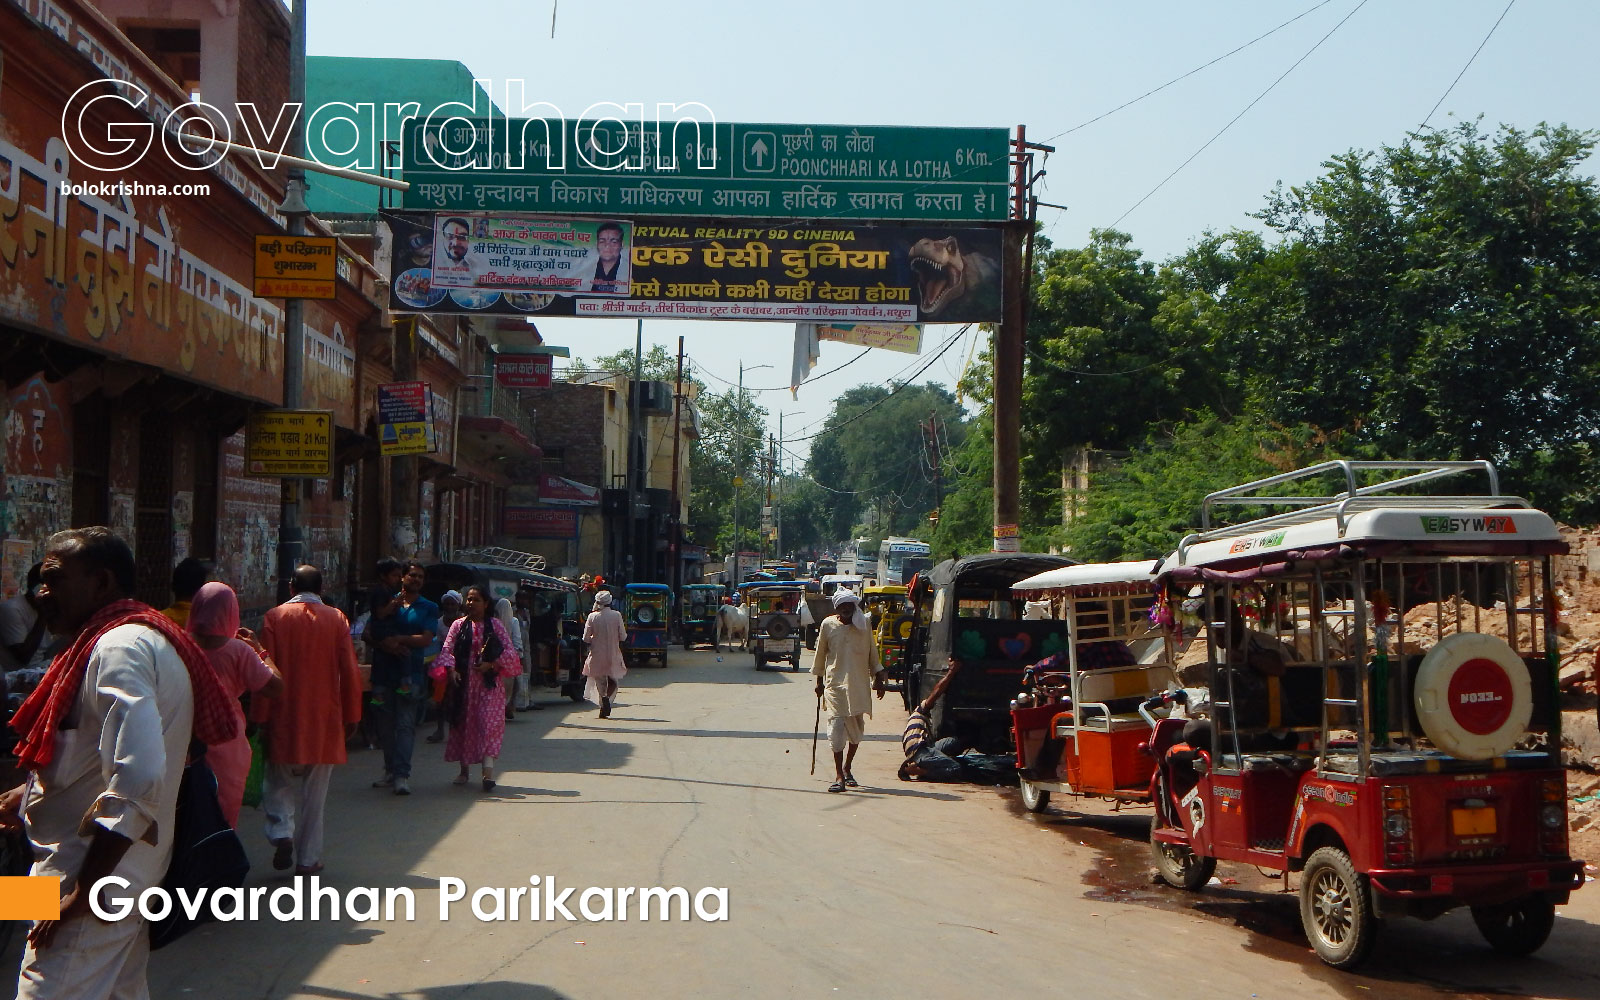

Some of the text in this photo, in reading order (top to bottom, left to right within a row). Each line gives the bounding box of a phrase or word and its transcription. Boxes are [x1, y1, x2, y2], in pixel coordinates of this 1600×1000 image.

[781, 127, 875, 156] पूछरी का लौठा
[453, 152, 512, 170] AANYOR
[781, 158, 952, 179] POONCHHARI KA LOTHA
[417, 183, 540, 207] मथुरा-वृन्दावन
[550, 180, 610, 205] विकास
[619, 180, 704, 207] प्राधिकरण
[712, 188, 771, 208] आपका
[782, 184, 838, 211] हार्दिक
[847, 192, 904, 210] स्वागत
[913, 193, 963, 211] करता
[492, 227, 592, 242] आज के पावन पर्व पर
[633, 226, 856, 241] IRTUAL REALITY 9D CINEMA
[285, 241, 332, 257] परिक्रमा
[472, 242, 486, 254] श्री
[487, 243, 527, 256] गिरिराज
[528, 245, 541, 257] जी
[488, 255, 510, 268] सभी
[557, 261, 571, 270] का
[632, 241, 890, 279] एक ऐसी दुनिया
[665, 278, 722, 299] आपने
[725, 279, 771, 300] कभी
[775, 279, 816, 301] नहीं
[818, 281, 861, 301] देखा
[865, 282, 912, 302] होगा
[675, 302, 708, 314] विकास
[731, 303, 741, 315] के
[304, 432, 313, 445] 21
